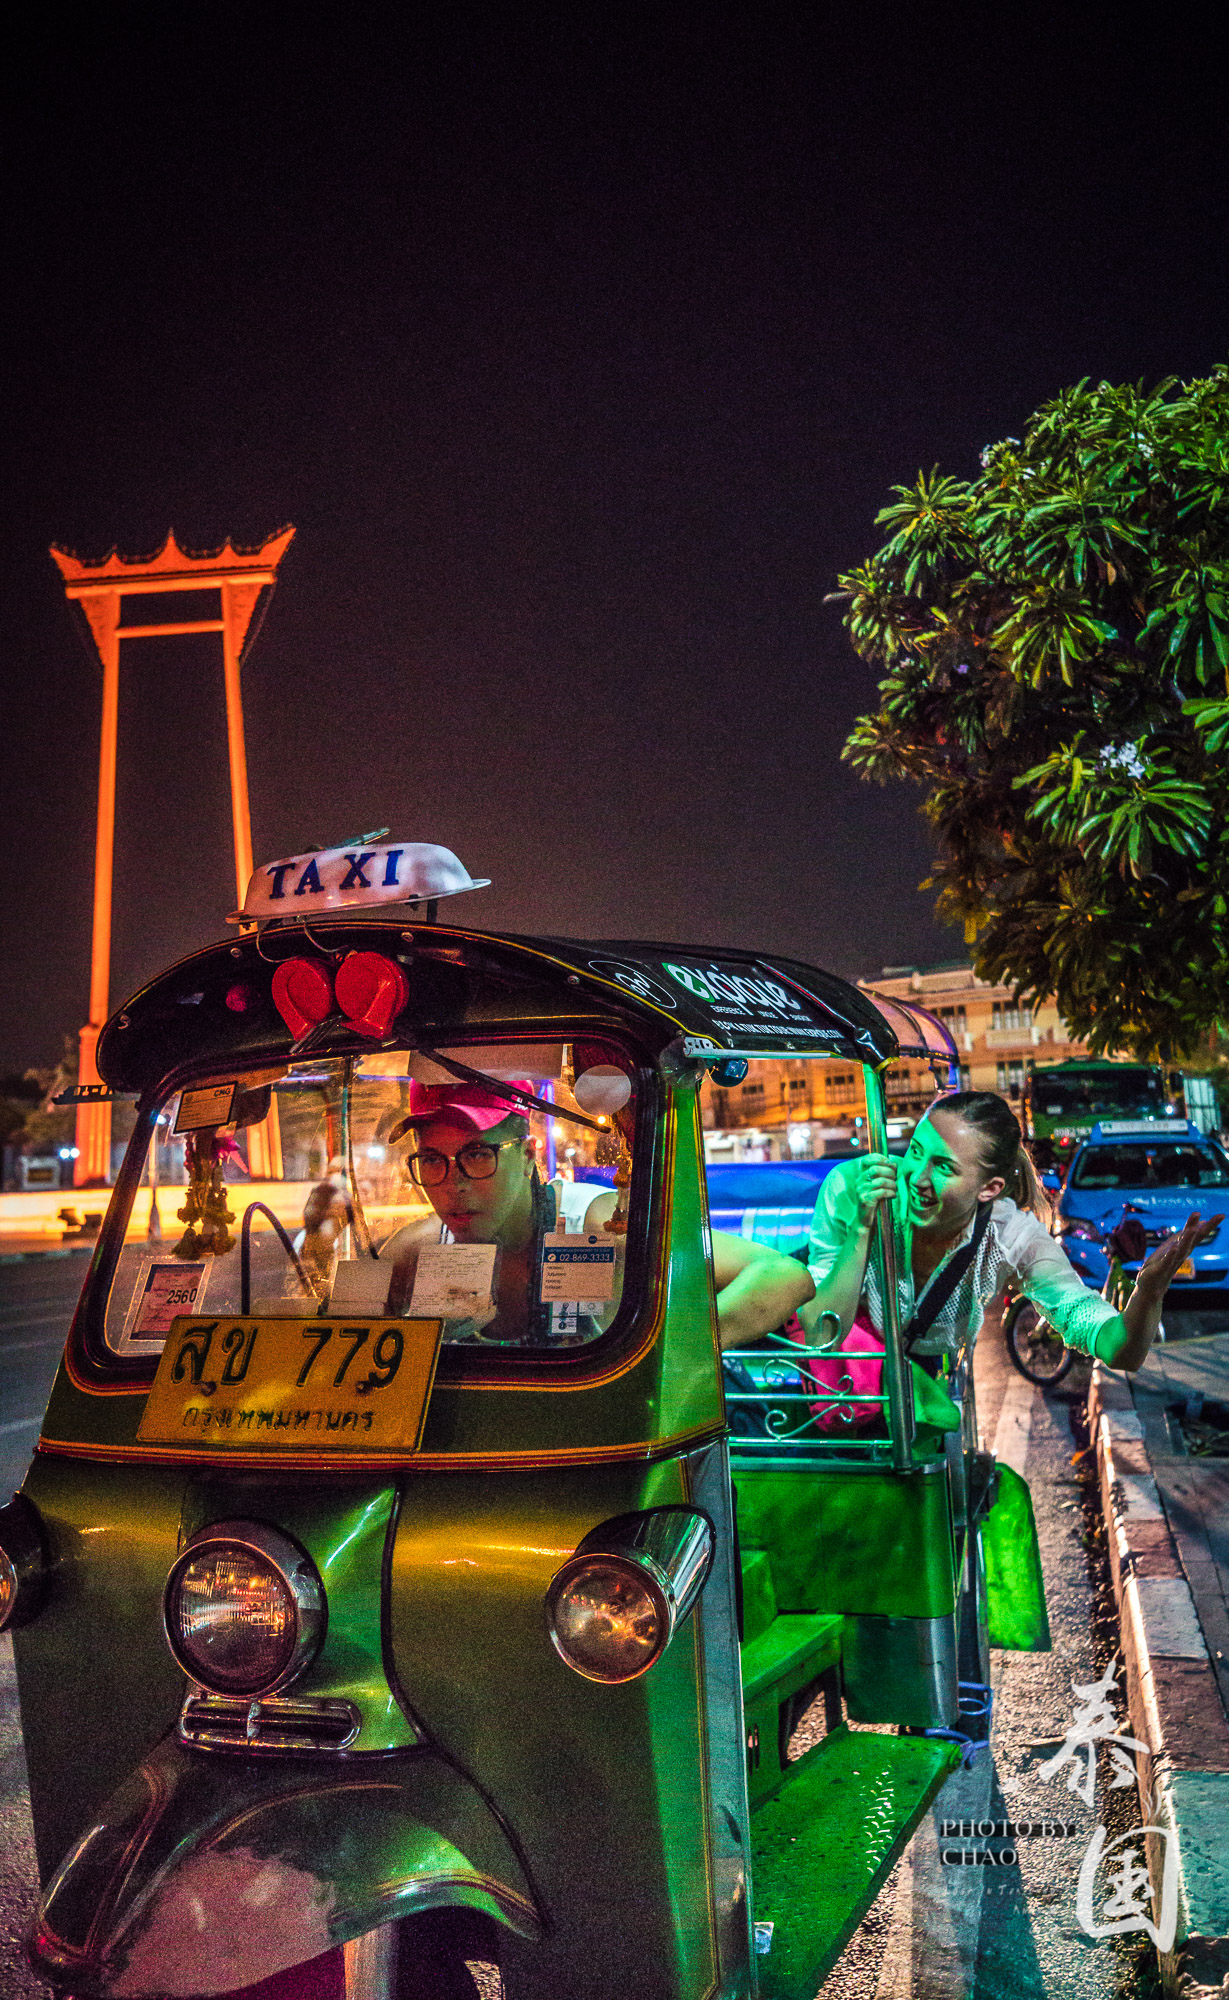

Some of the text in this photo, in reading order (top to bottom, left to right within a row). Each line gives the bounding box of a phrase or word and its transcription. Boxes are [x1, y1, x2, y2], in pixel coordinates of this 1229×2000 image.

[267, 849, 404, 899] TAXI
[213, 1087, 231, 1097] CNG
[559, 1253, 610, 1262] 02-869-3333
[166, 1288, 198, 1304] 2560
[171, 1321, 404, 1388] สข 779
[182, 1406, 377, 1432] กรุงเทพมหานคร
